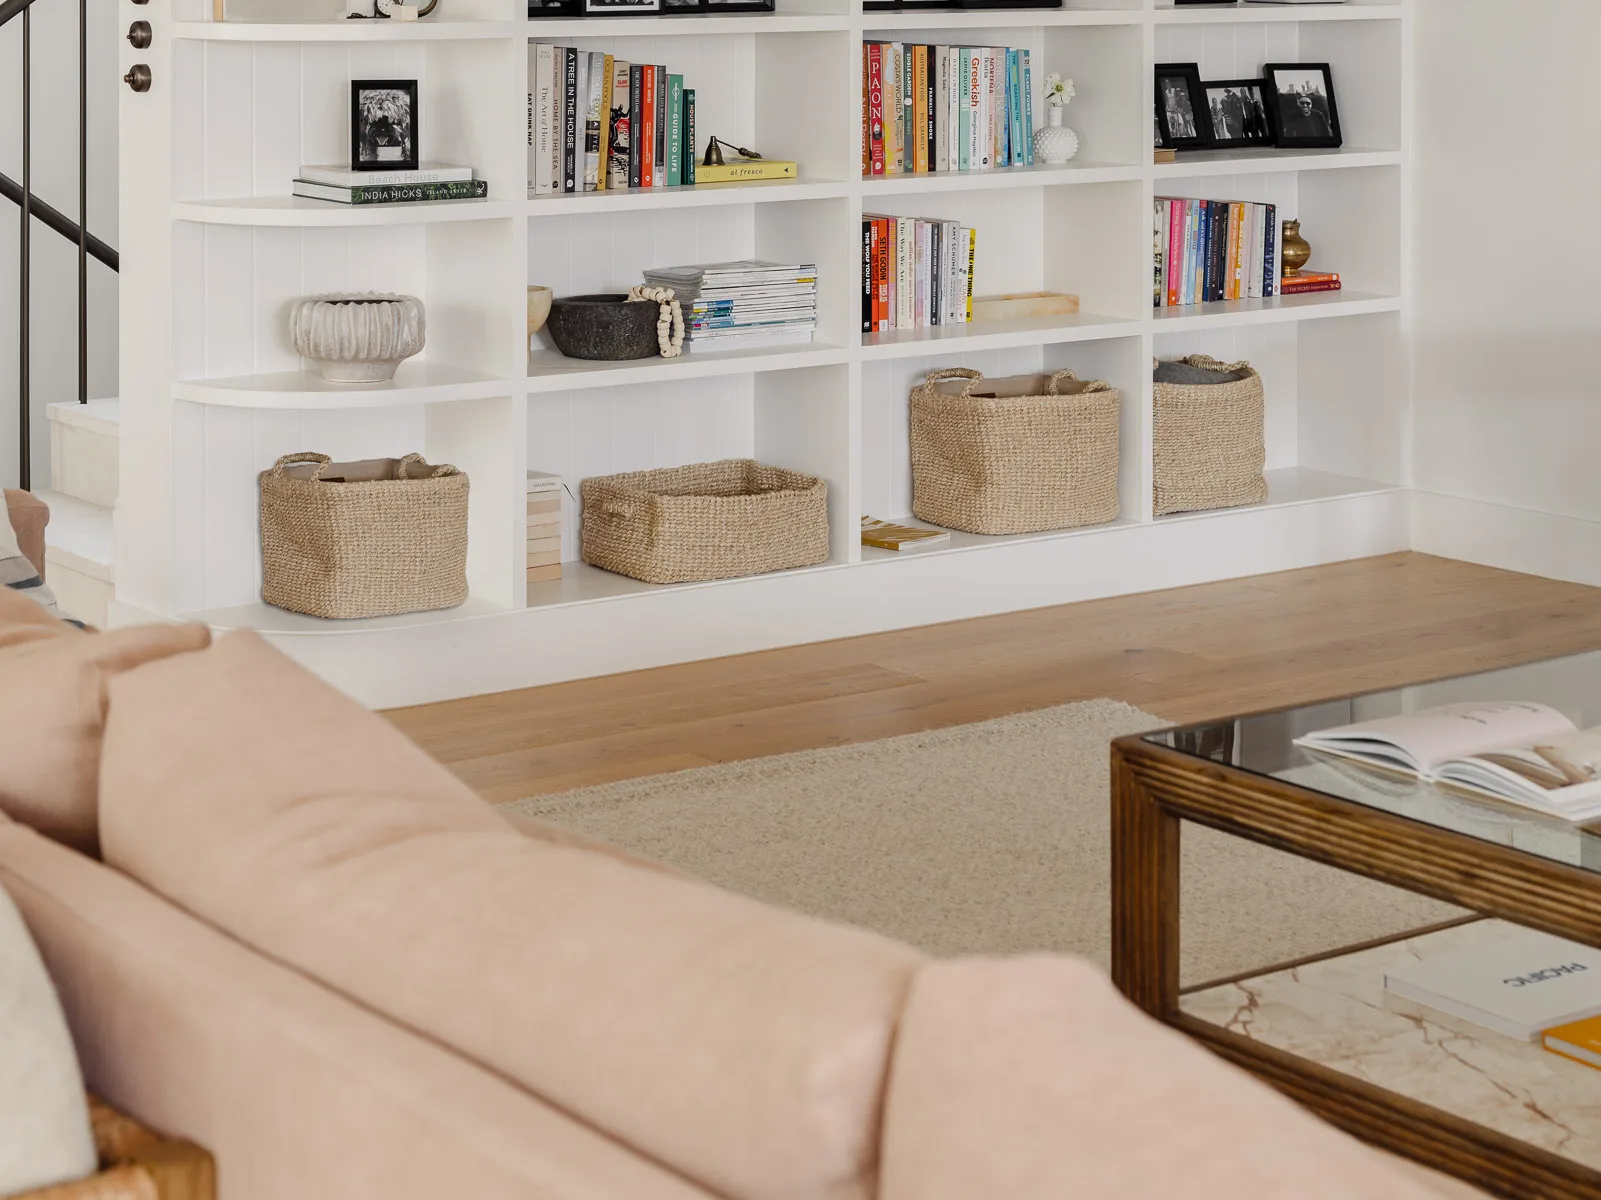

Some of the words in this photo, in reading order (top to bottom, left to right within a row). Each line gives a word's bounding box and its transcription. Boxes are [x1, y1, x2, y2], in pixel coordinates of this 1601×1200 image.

[894, 53, 902, 85] COSTA'S
[970, 57, 980, 107] Greekish
[541, 86, 549, 103] The
[568, 86, 575, 96] IN
[541, 103, 549, 117] Art
[567, 97, 575, 116] THE
[552, 125, 559, 135] BY
[566, 117, 574, 149] HOUSE
[541, 127, 549, 153] Home
[672, 142, 679, 153] TO
[671, 155, 679, 173] LIFE
[368, 174, 400, 185] Beach
[404, 173, 439, 183] House
[740, 168, 764, 177] fresco
[361, 190, 389, 200] INDIA
[391, 188, 422, 199] HICKS
[899, 255, 905, 268] We
[1502, 962, 1589, 988] PACIFIC
